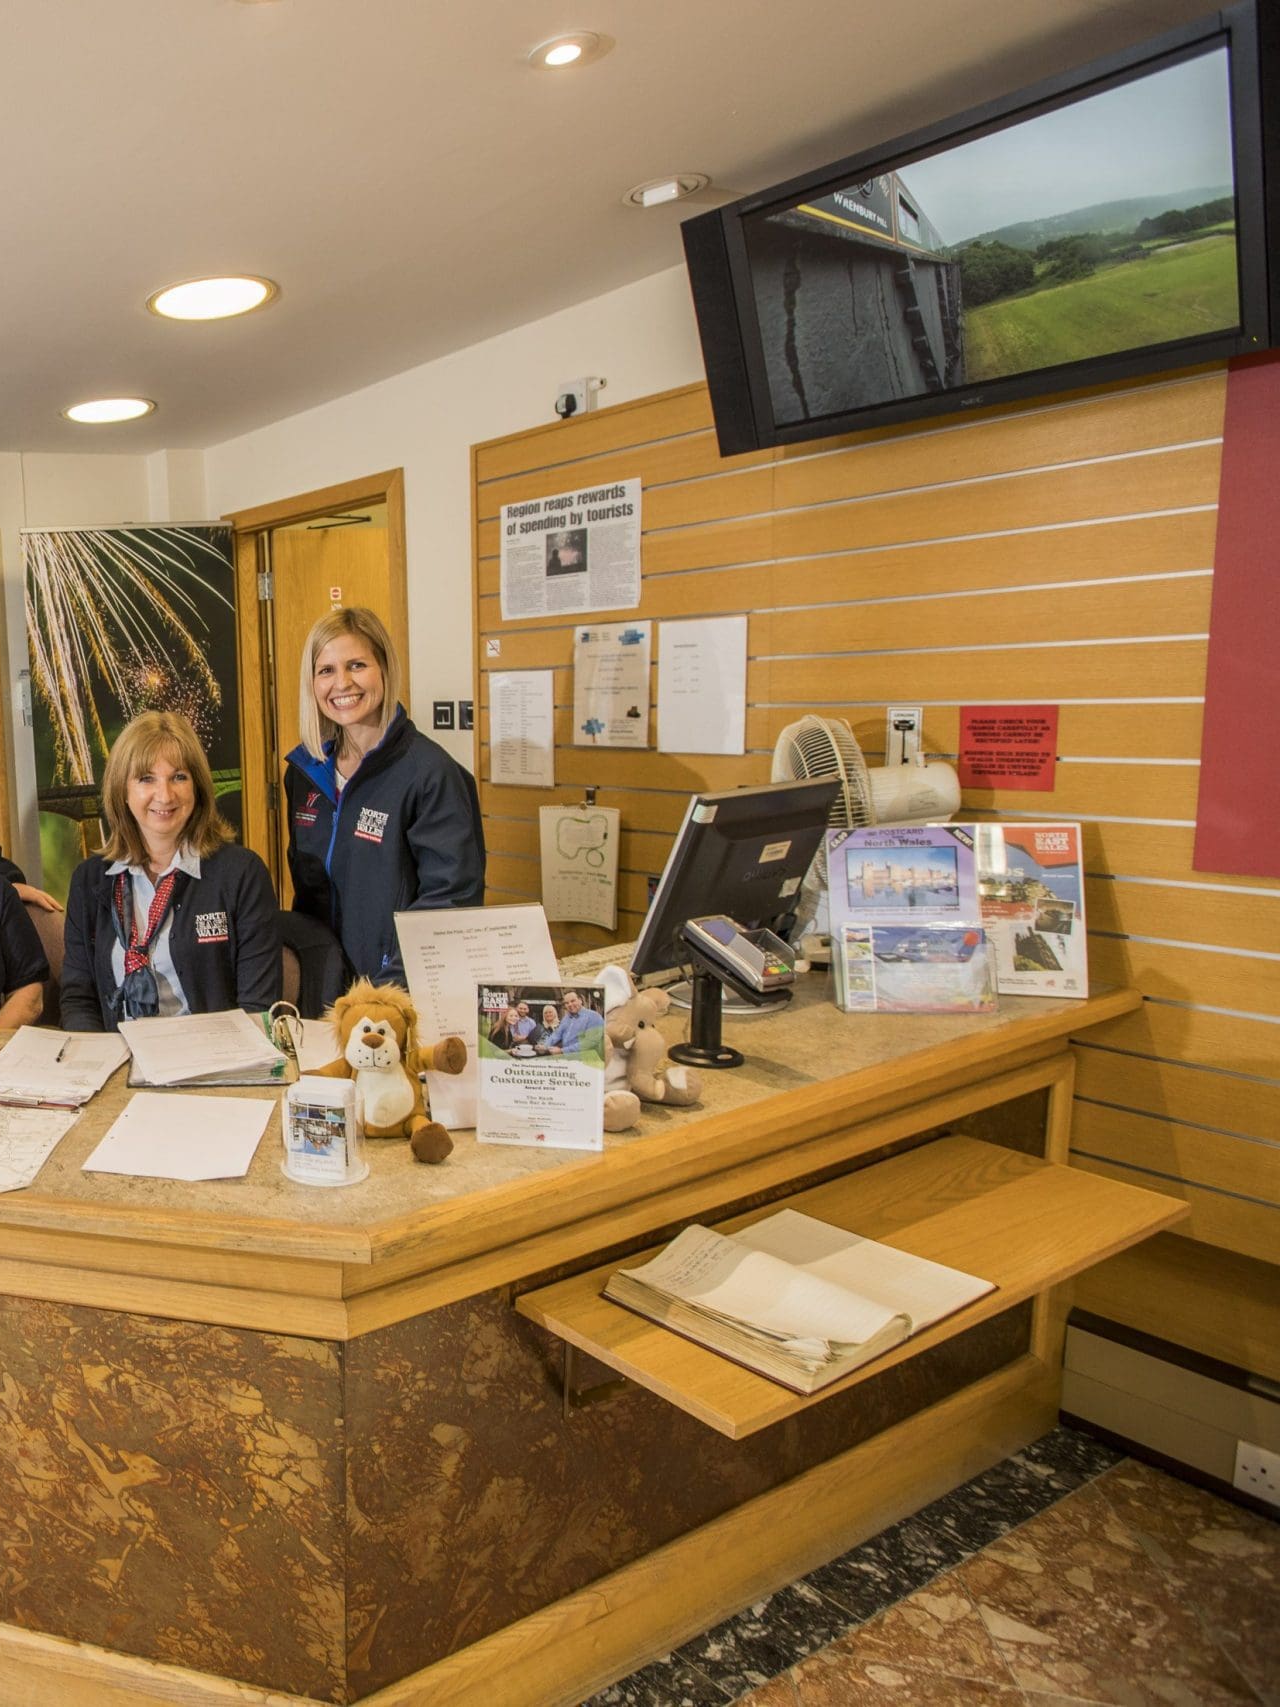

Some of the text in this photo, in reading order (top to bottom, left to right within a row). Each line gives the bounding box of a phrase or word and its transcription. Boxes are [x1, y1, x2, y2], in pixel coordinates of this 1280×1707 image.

[833, 192, 876, 222] WRENBURY
[508, 485, 626, 518] Region reaps rewards
[506, 504, 634, 536] of spending by tourists
[360, 807, 389, 820] NORTH
[357, 820, 384, 837] WALES
[898, 838, 934, 846] Wales
[196, 912, 226, 921] NORTH
[196, 928, 228, 938] WALES
[504, 1068, 576, 1080] Outstanding
[490, 1076, 591, 1088] Customer Service
